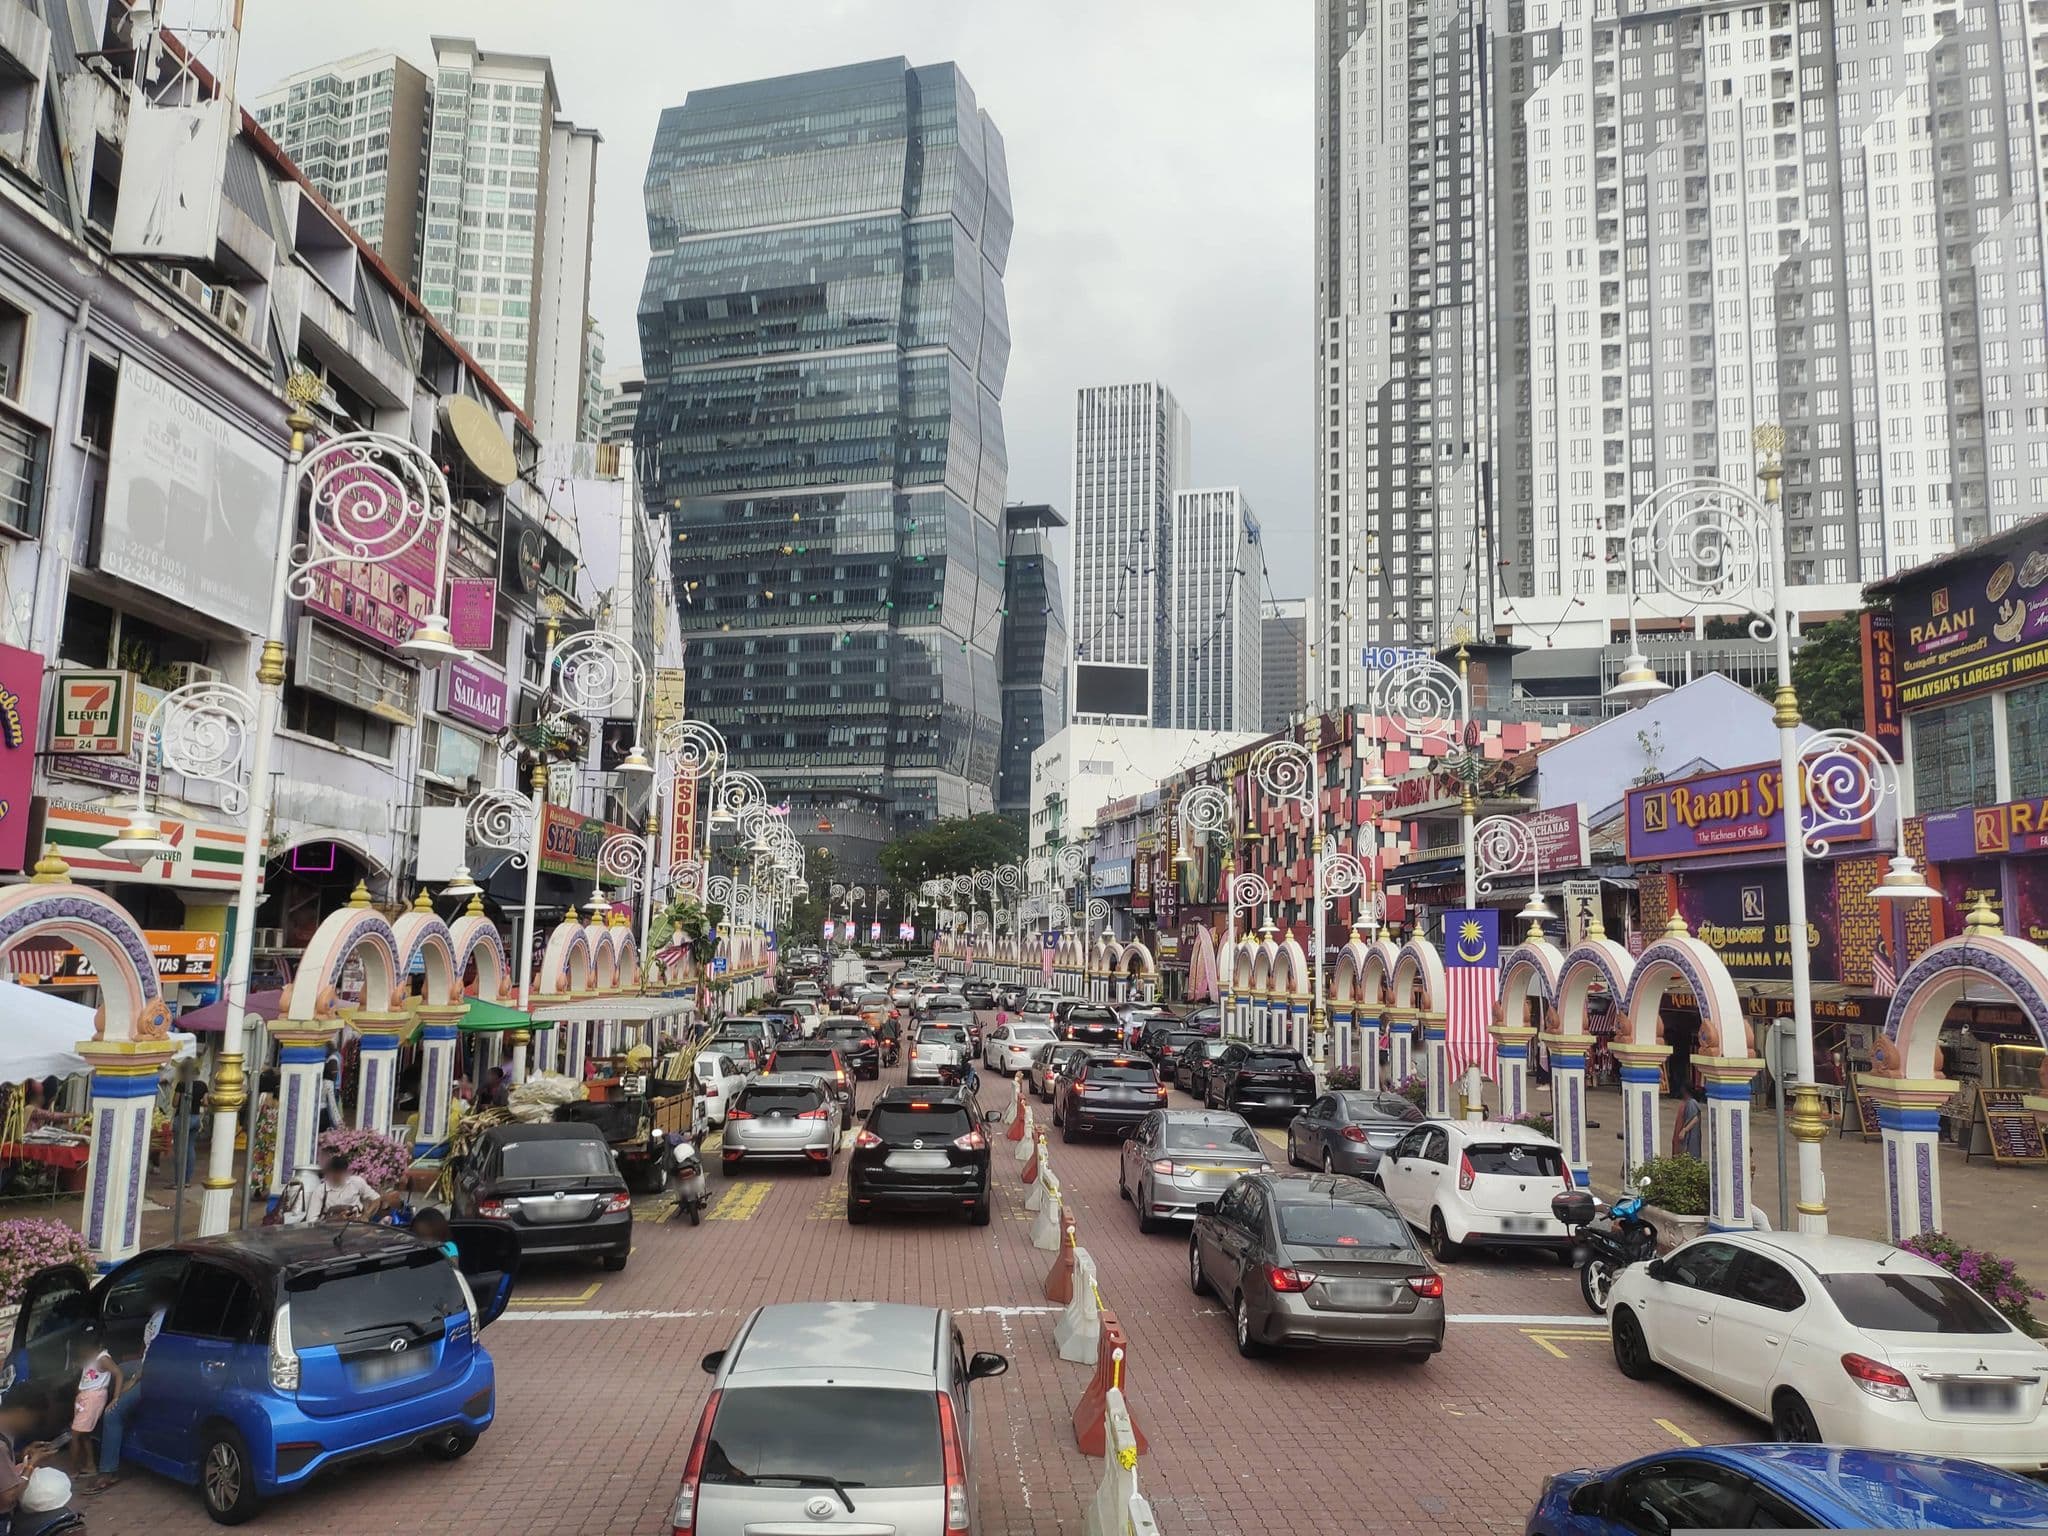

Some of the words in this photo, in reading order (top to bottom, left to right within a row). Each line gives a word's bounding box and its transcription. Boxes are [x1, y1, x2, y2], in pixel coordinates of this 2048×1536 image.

[1909, 607, 1976, 646] RAANI
[1872, 630, 1893, 719] Raani
[1903, 673, 1960, 703] MALAYSIA'S
[1963, 661, 2009, 686] LARGEST
[71, 686, 110, 735] 7
[78, 739, 92, 749] 24
[1670, 778, 1751, 829] Raani
[1698, 832, 1710, 842] The
[1710, 828, 1737, 841] Richness
[1737, 826, 1747, 839] Of
[1747, 825, 1764, 838] Silks
